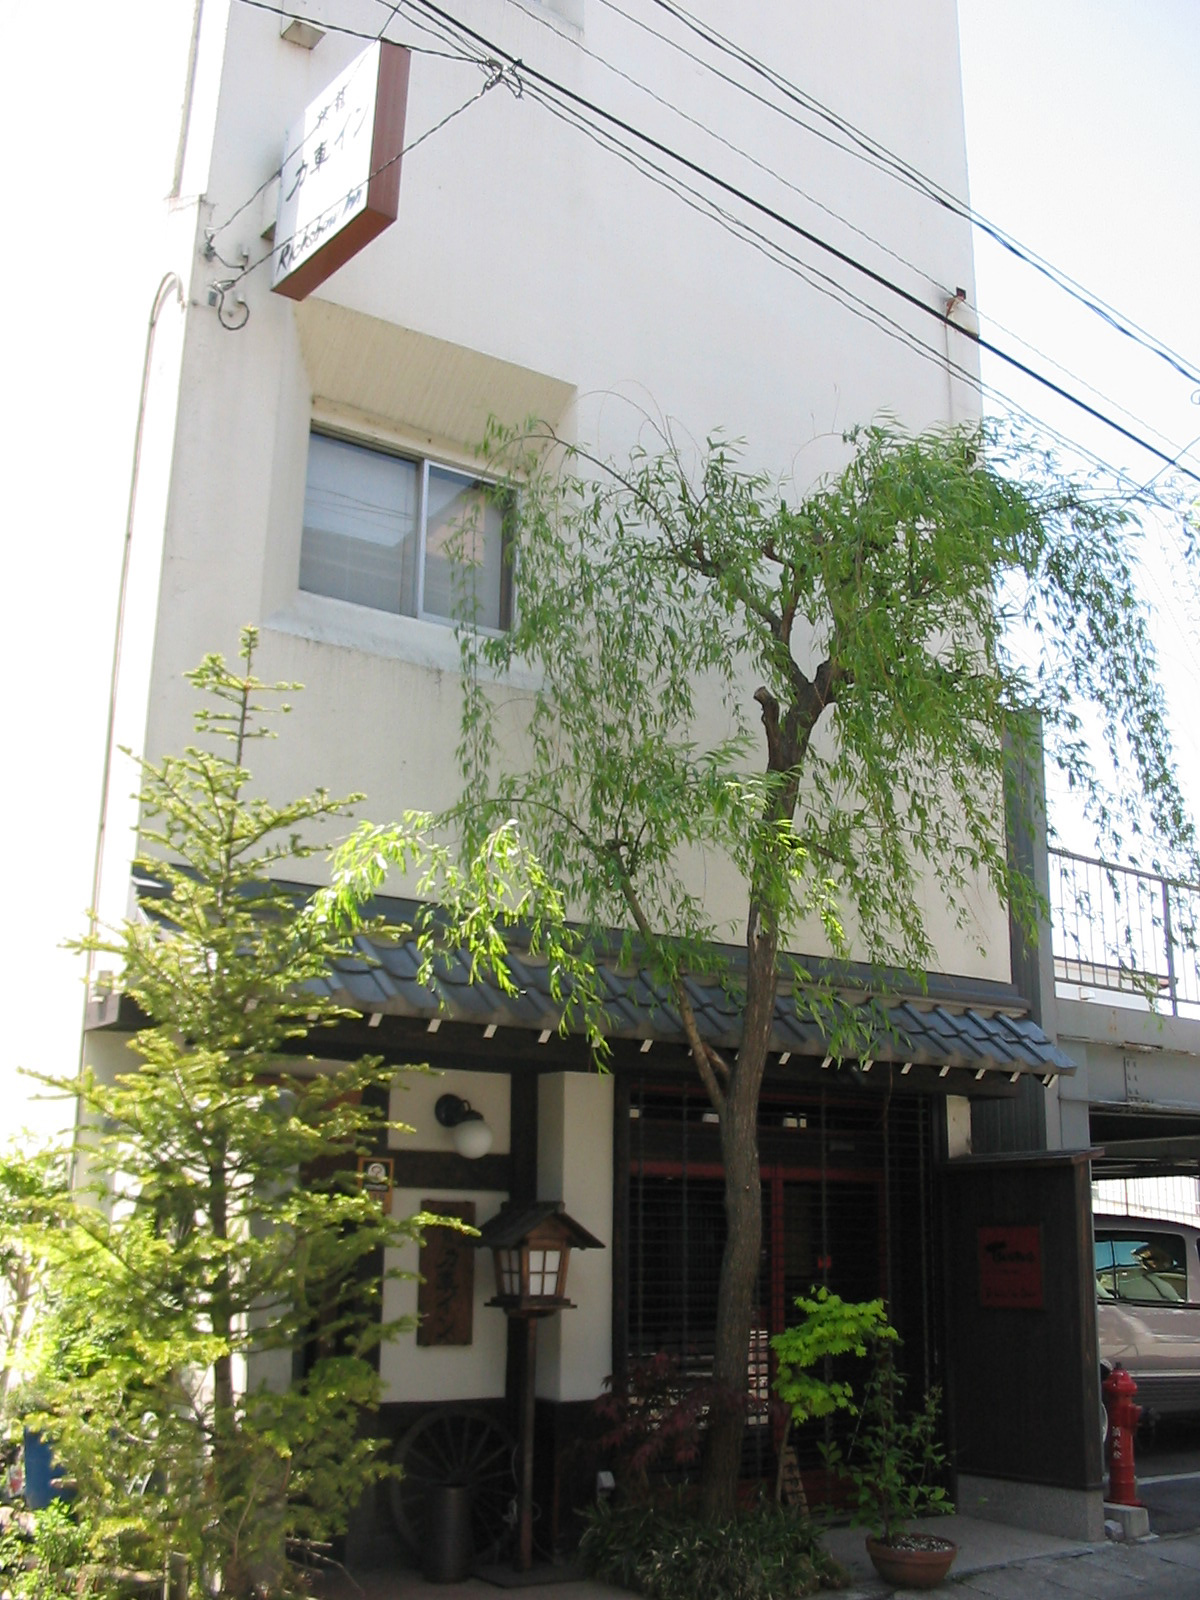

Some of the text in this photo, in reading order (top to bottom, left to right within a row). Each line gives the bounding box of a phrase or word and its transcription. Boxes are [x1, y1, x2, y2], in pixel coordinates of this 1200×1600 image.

[285, 103, 370, 203] 力車イン
[1111, 1425, 1123, 1460] 消火栓
